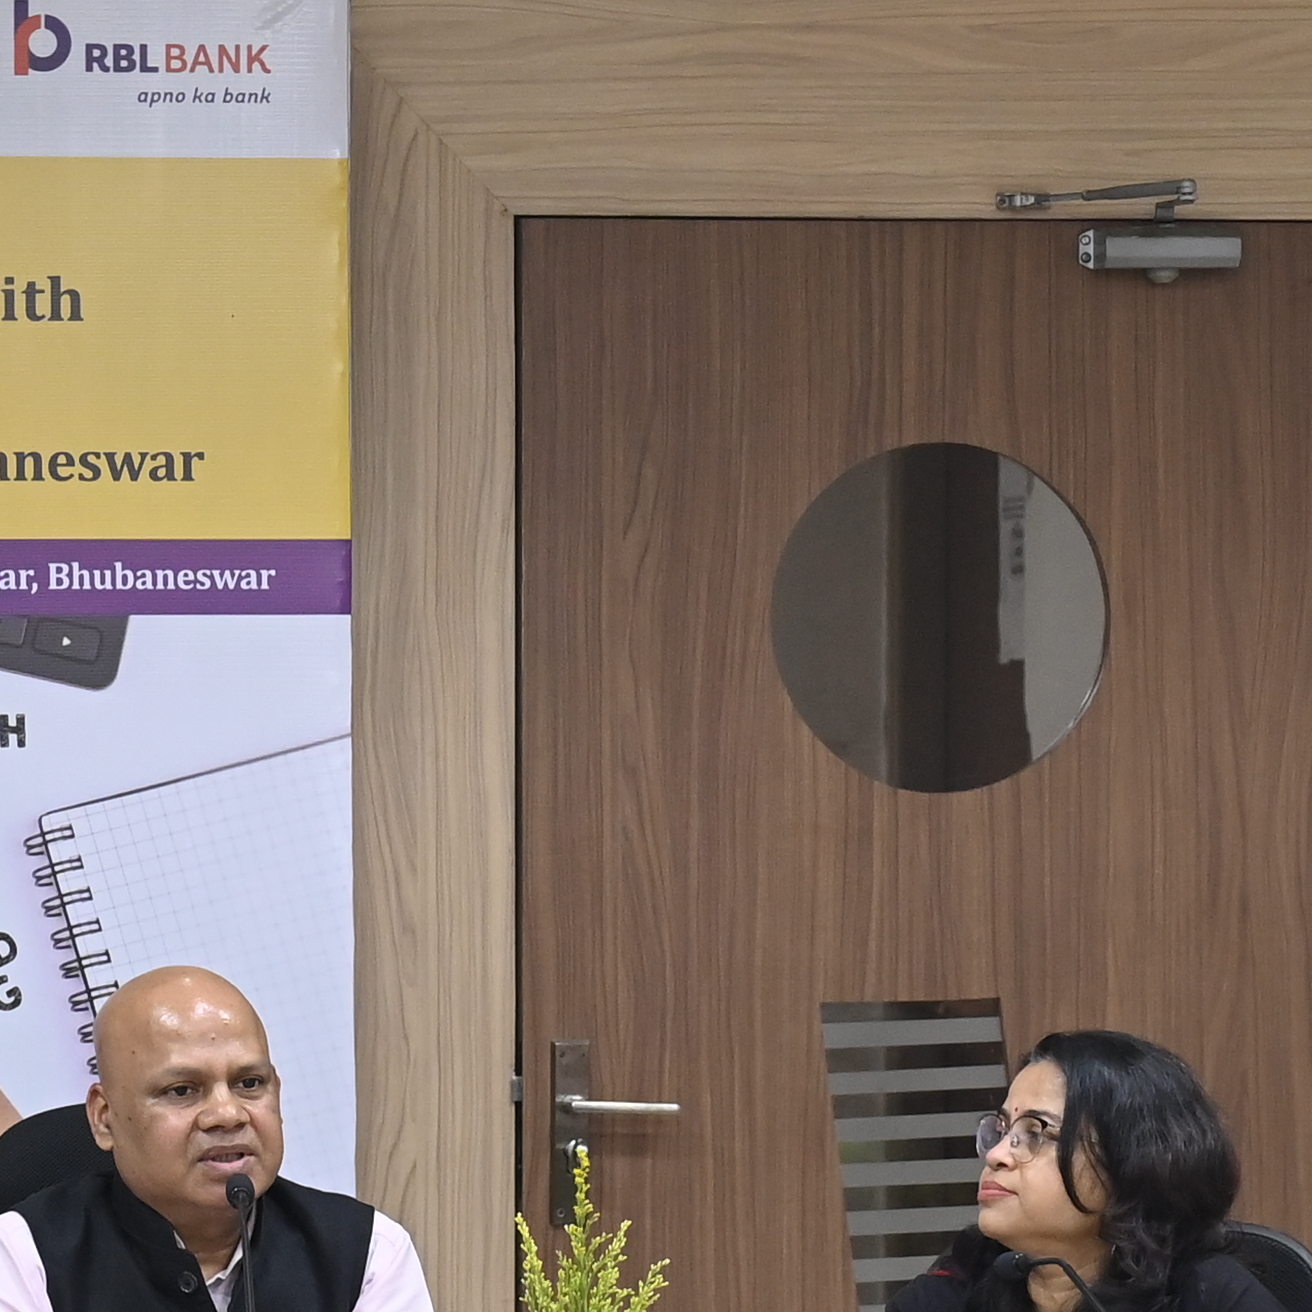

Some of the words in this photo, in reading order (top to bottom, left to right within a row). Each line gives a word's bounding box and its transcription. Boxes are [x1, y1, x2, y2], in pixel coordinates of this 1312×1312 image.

[138, 91, 186, 108] apno
[192, 87, 217, 104] ka
[222, 87, 272, 104] bank
[47, 563, 276, 592] Bhubaneswar
